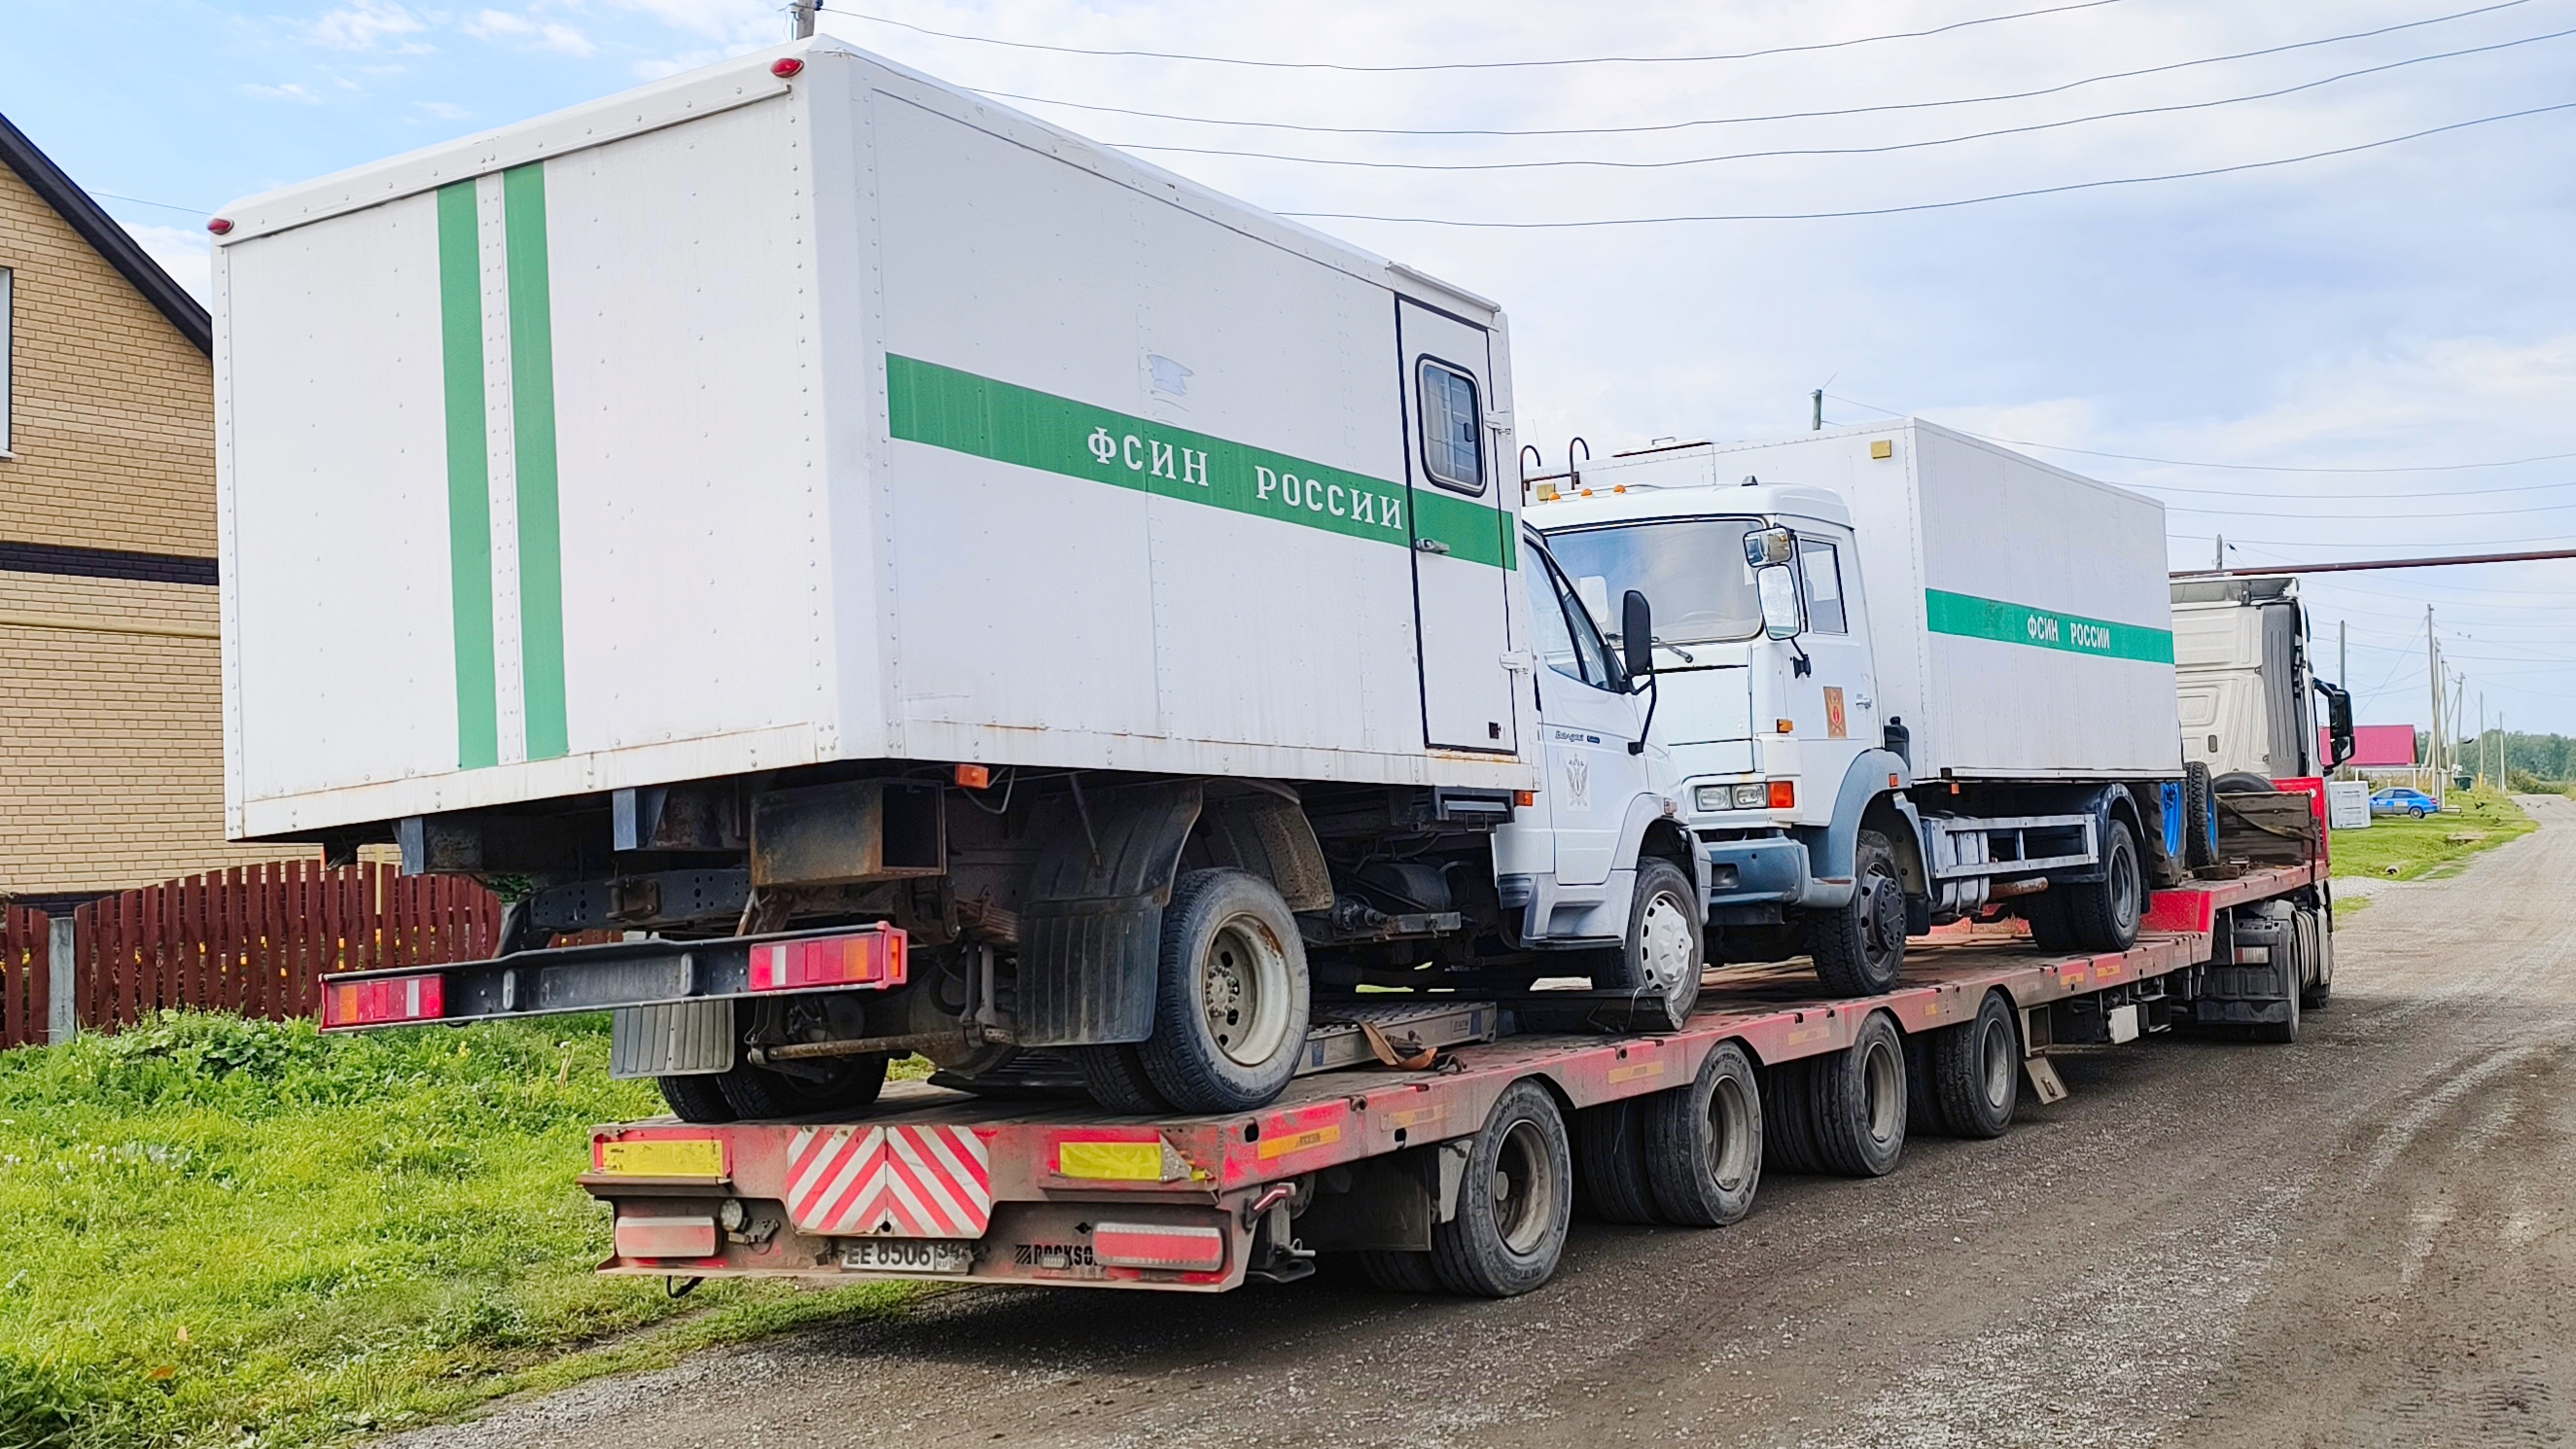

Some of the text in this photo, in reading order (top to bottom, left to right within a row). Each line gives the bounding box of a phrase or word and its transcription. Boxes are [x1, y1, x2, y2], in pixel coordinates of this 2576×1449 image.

[1087, 426, 1403, 530] ФСИН РОССИИ
[2027, 614, 2110, 650] ФСИН РОССИИ
[1034, 1244, 1099, 1266] ROCKSO
